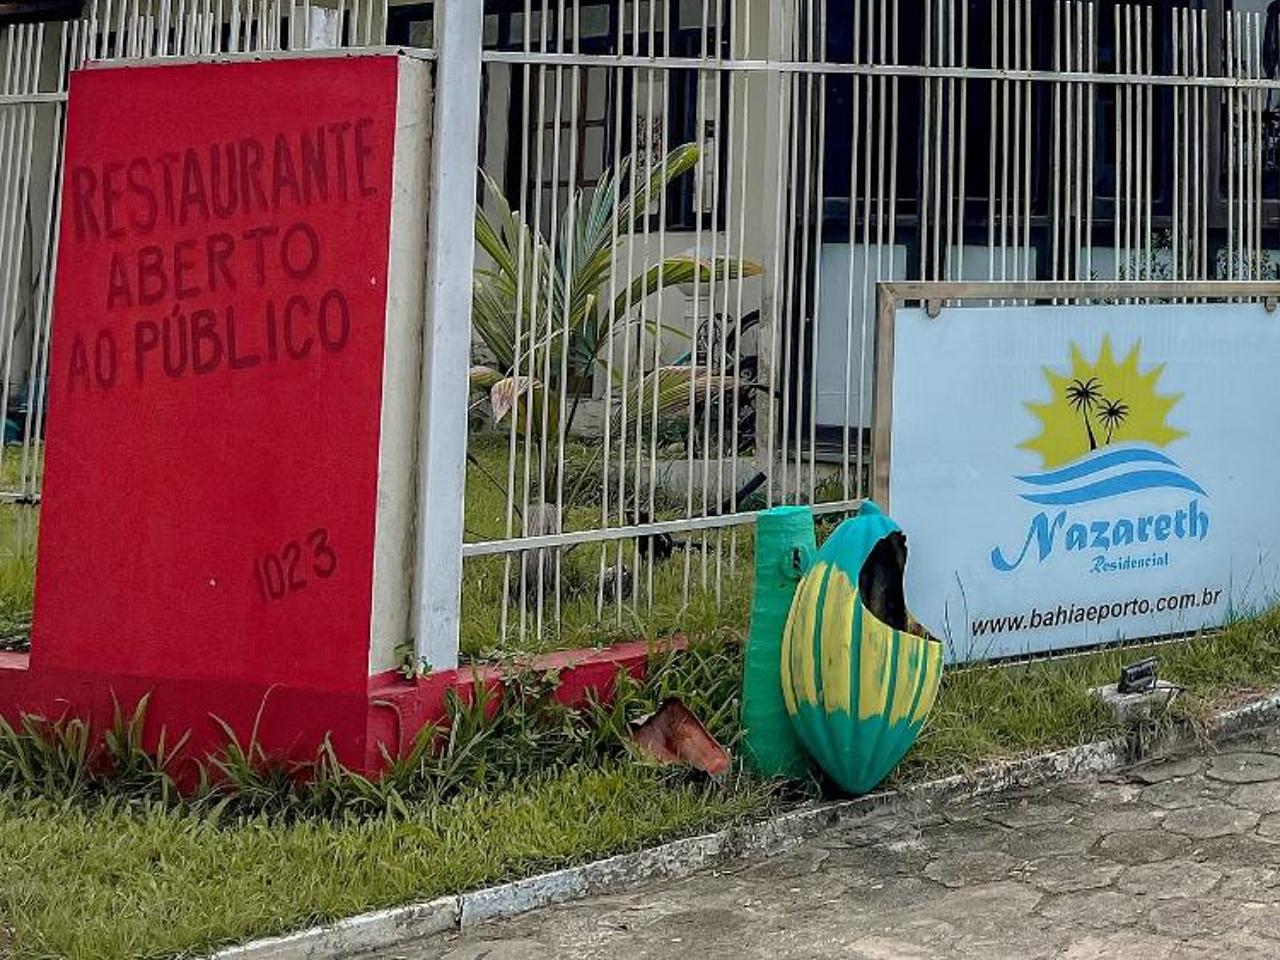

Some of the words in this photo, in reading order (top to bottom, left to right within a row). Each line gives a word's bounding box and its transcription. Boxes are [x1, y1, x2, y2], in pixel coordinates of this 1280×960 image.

[71, 118, 378, 241] RESTAURANTE
[107, 222, 320, 311] ABERTO
[67, 328, 117, 393] AO
[134, 289, 351, 384] PÚBLICO
[253, 527, 339, 606] 1023
[990, 498, 1210, 573] Nazareth
[1089, 552, 1169, 575] Residencial
[970, 586, 1223, 638] www.bahiaeporto.com.br
